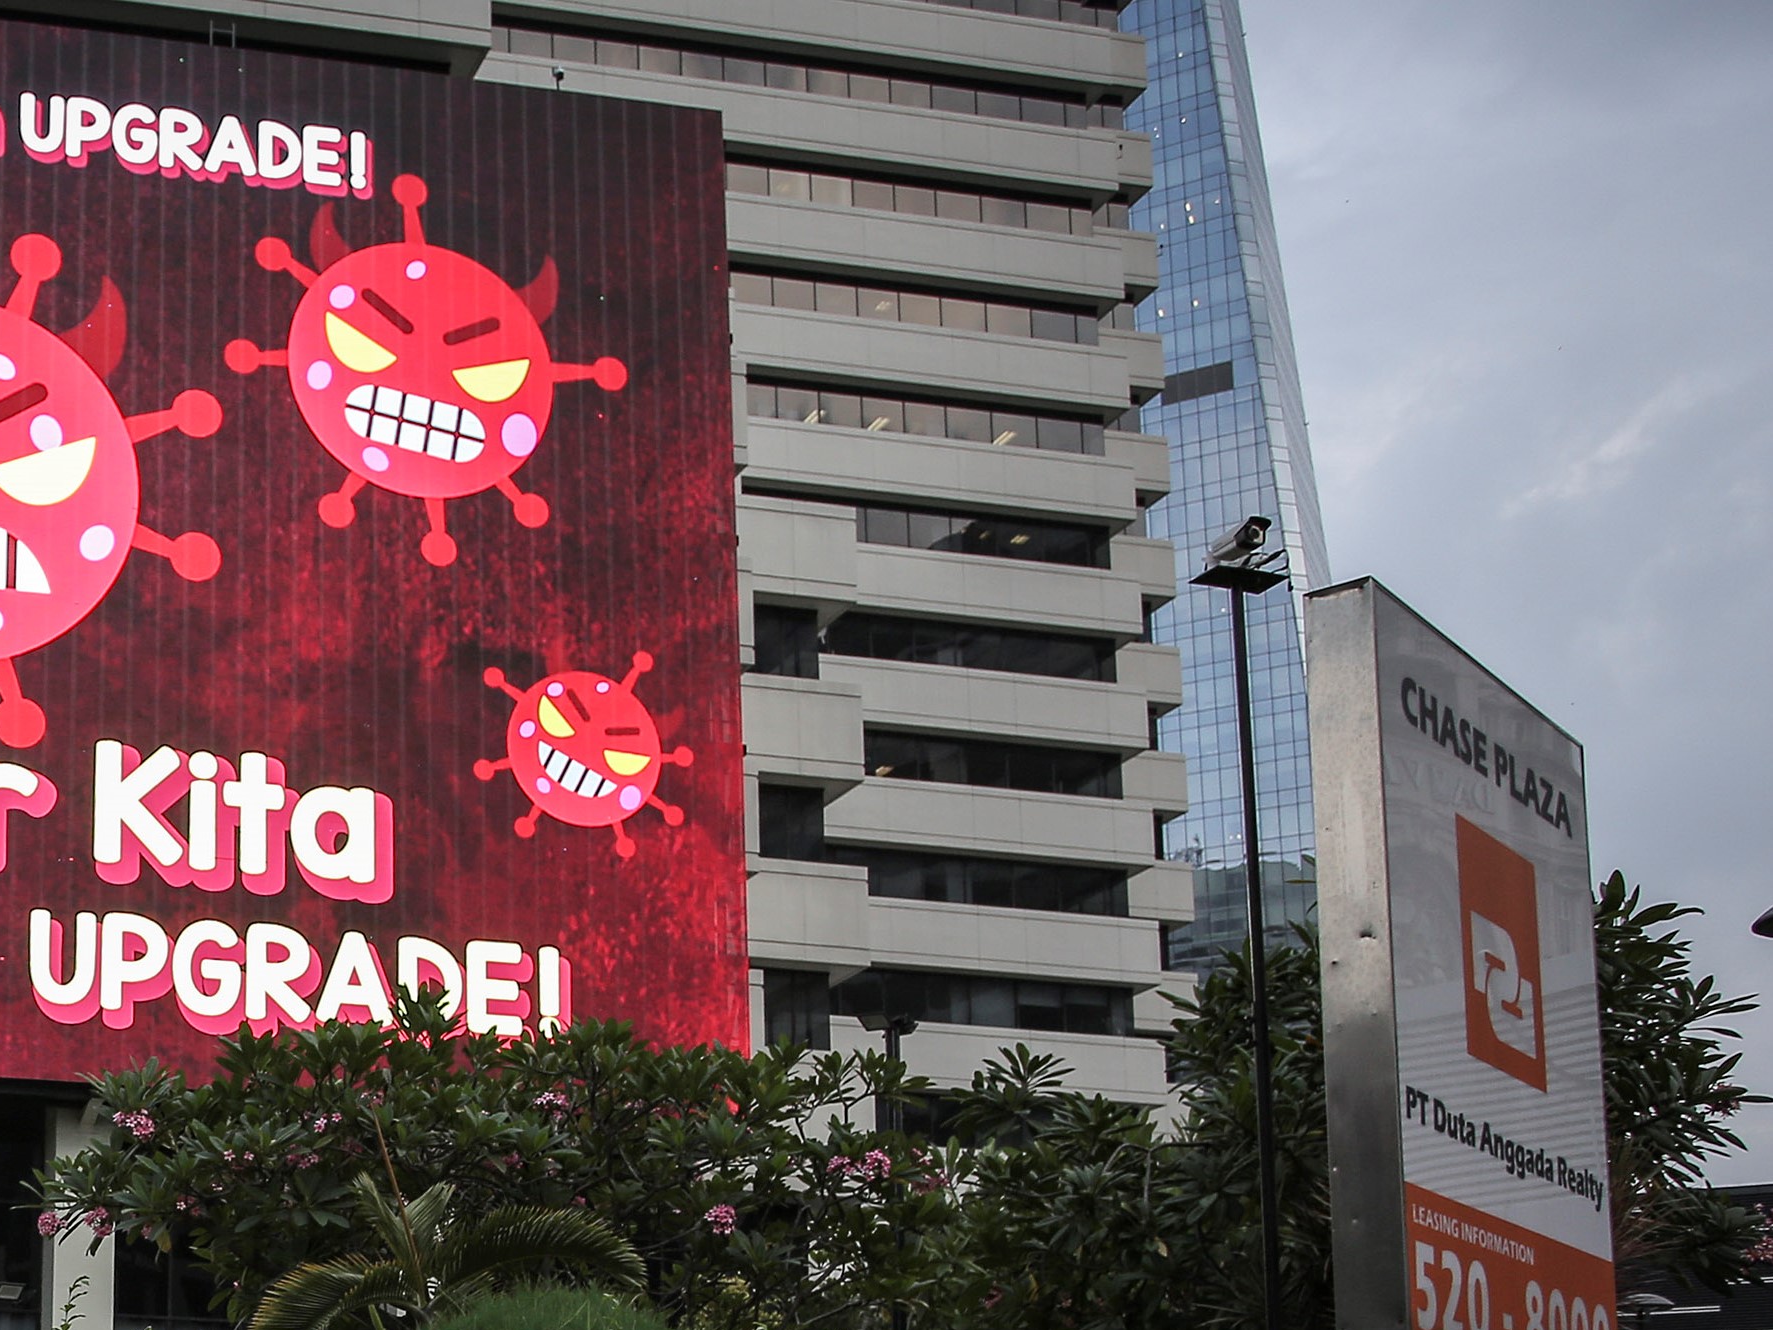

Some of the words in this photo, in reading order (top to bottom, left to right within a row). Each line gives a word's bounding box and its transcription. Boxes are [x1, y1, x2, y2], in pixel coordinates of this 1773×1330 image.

[19, 92, 368, 190] UPGRADE!
[92, 739, 394, 884] Kita
[1400, 676, 1489, 779] CHASE
[1493, 742, 1574, 840] PLAZA
[29, 908, 562, 1039] UPGRADE!
[1405, 1085, 1429, 1127] PT
[1432, 1097, 1477, 1148] Duta
[1479, 1121, 1555, 1184] Anggada
[1556, 1155, 1605, 1213] Realty
[1412, 1204, 1459, 1239] LEASING
[1460, 1222, 1535, 1266] INFORMATION
